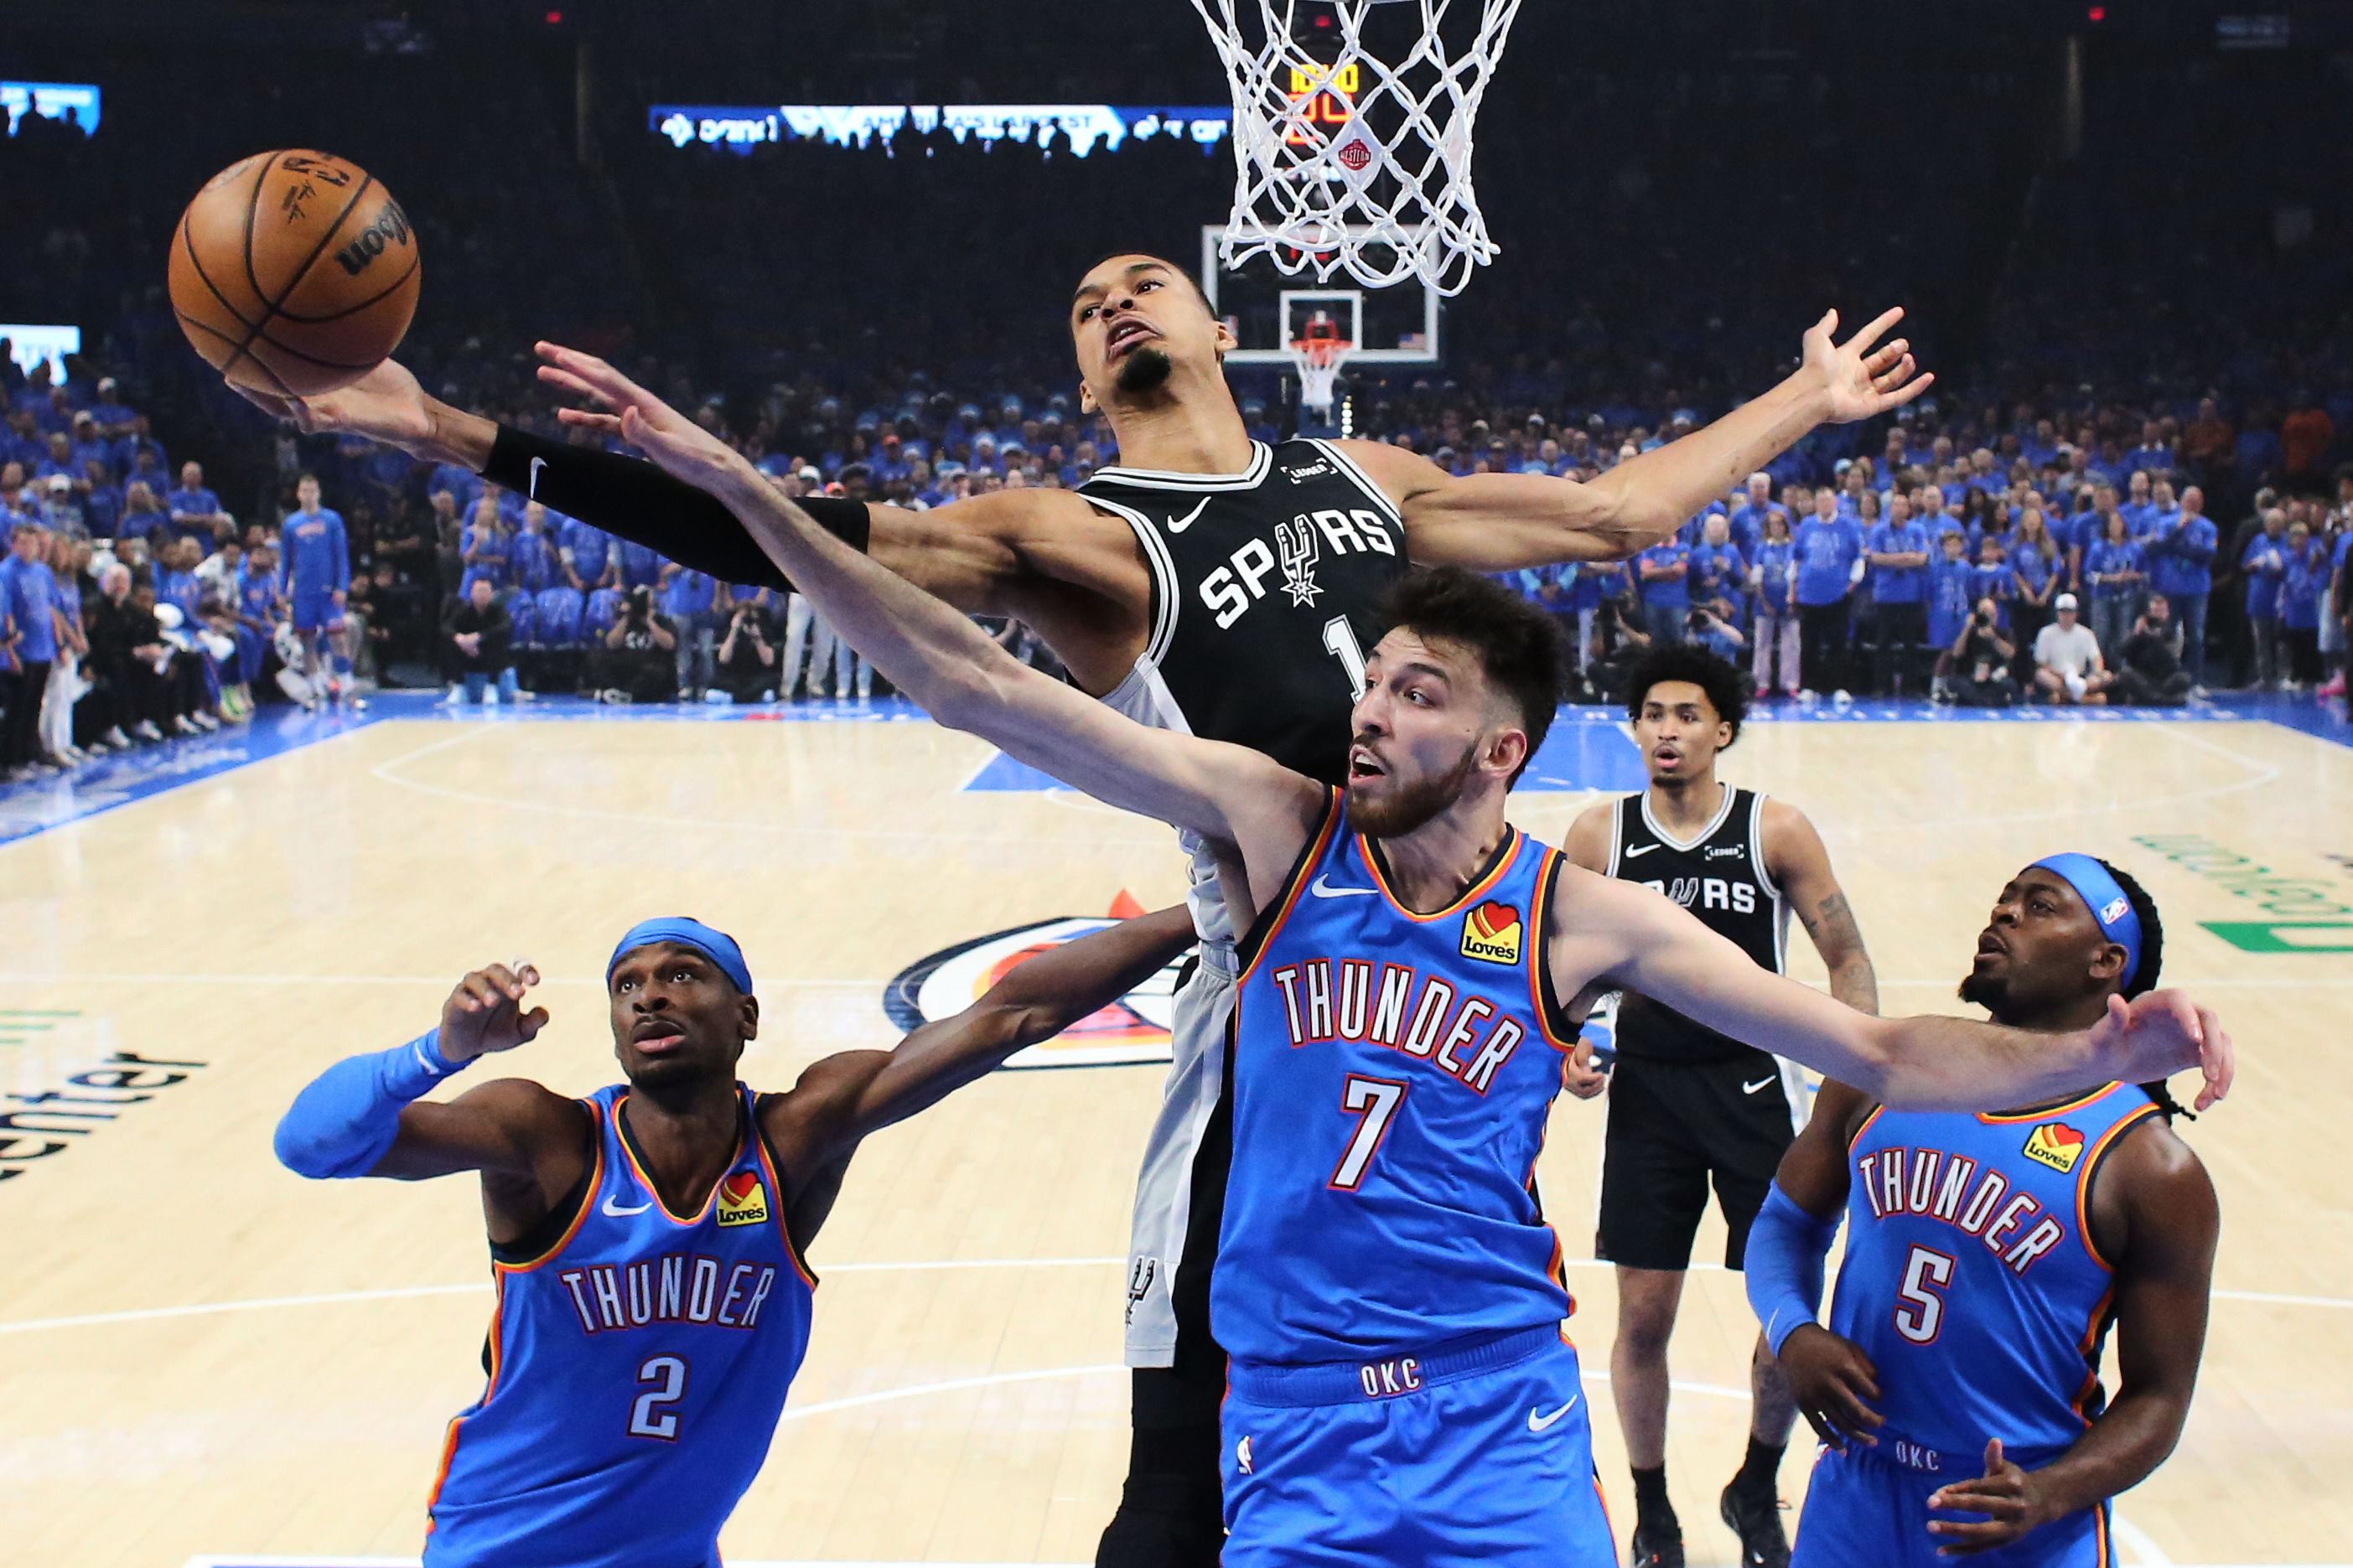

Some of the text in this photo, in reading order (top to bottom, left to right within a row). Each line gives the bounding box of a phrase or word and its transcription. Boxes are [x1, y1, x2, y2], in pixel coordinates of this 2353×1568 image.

[1199, 514, 1397, 630] SPURS
[1322, 613, 1367, 705] 1
[1272, 958, 1526, 1097] THUNDER
[1326, 1073, 1409, 1192] 7
[1858, 1147, 2065, 1277] THUNDER
[557, 1253, 777, 1336] THUNDER
[1893, 1242, 1957, 1347] 5
[626, 1353, 690, 1443] 2
[1359, 1356, 1423, 1397] OKC
[1895, 1441, 1939, 1471] OKC
